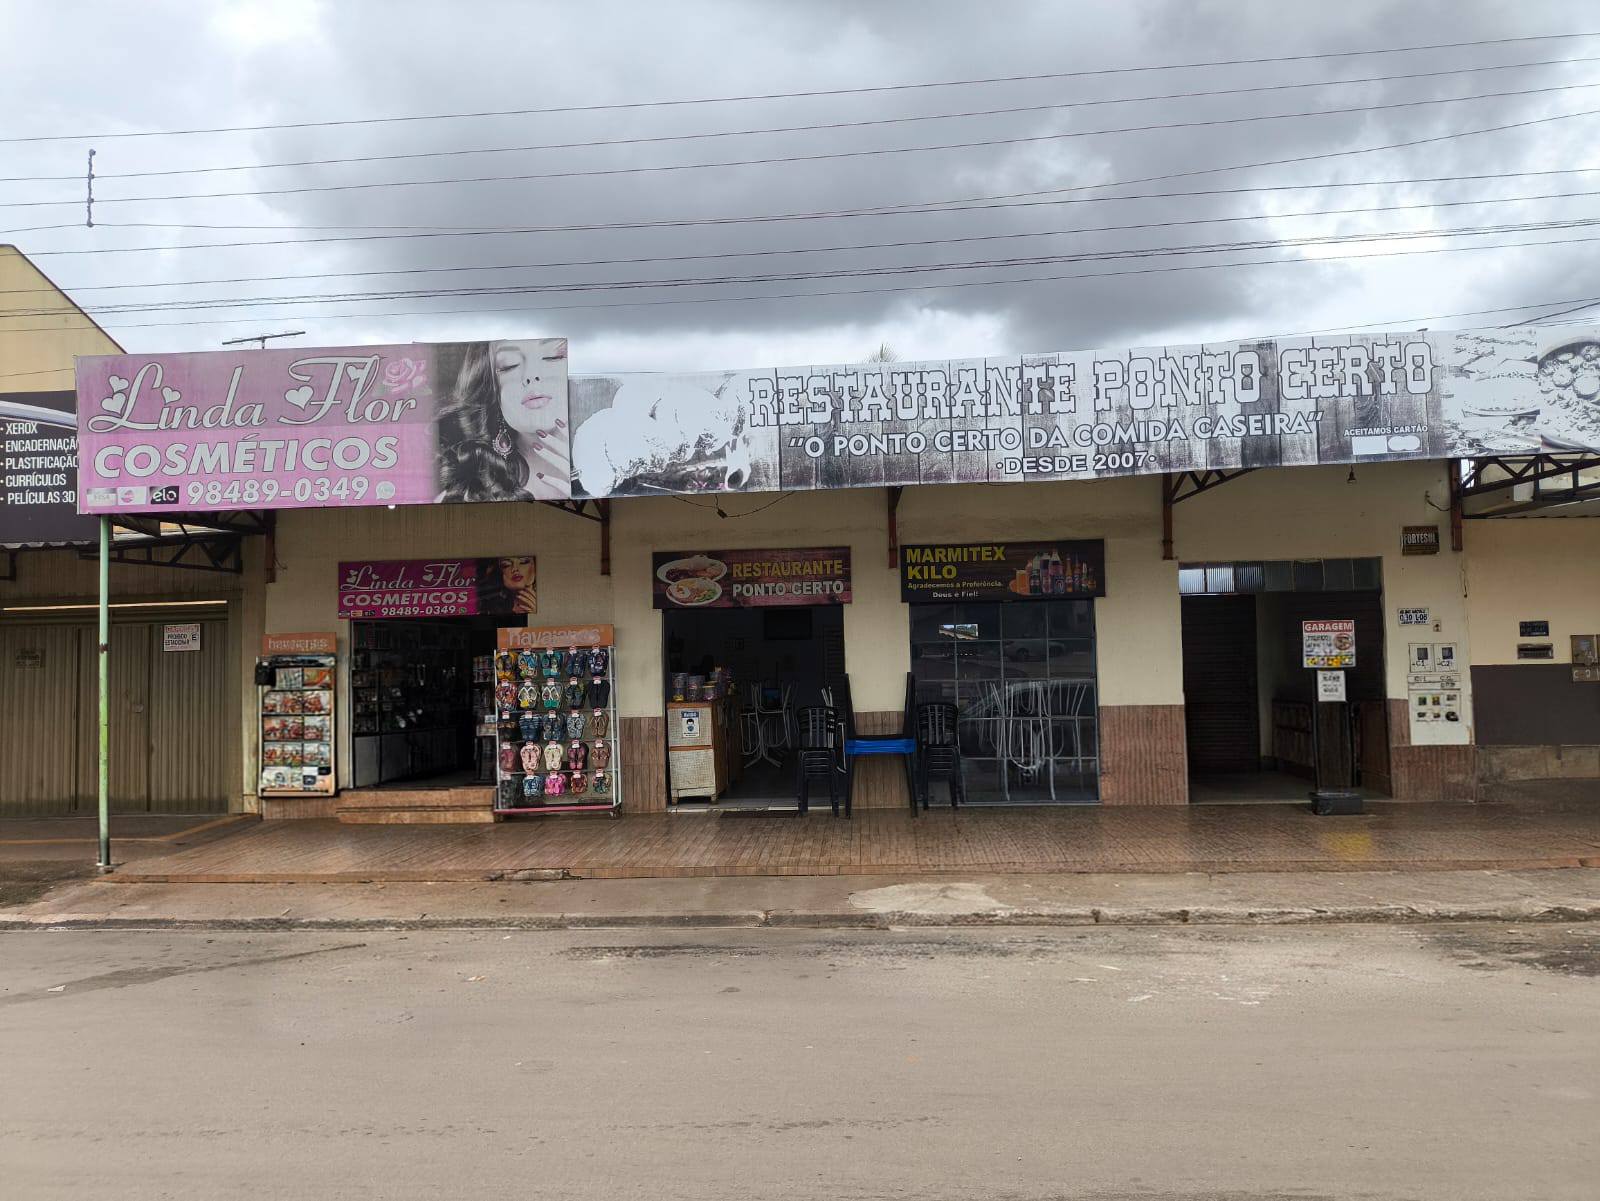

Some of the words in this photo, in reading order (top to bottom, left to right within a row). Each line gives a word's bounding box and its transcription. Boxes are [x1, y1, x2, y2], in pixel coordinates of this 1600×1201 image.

[749, 363, 1076, 427] RESTAURANTE
[1093, 350, 1261, 412] PONTO
[1278, 341, 1434, 400] CERTO
[87, 360, 266, 433] Linda
[277, 354, 417, 426] Flor
[5, 422, 38, 435] XEROX
[834, 431, 927, 457] PONTO
[934, 427, 1022, 454] CERTO
[1029, 426, 1069, 450] DA
[1073, 417, 1188, 447] COMIDA
[1344, 427, 1392, 437] ACEITAMOS
[1393, 423, 1428, 434] CARTÃO
[5, 436, 79, 453] ENCADERNAÇÃ
[93, 433, 400, 479] COSMÉTICOS
[5, 471, 67, 488] CURRÍCULOS
[7, 488, 60, 505] PELÍCULAS
[62, 490, 75, 503] 3D
[152, 488, 177, 502] elo
[186, 475, 370, 505] 98489-0349
[906, 546, 1006, 563] MARMITEX
[340, 565, 414, 591] Linda
[419, 562, 476, 588] Flor
[732, 559, 843, 577] RESTAURANTE
[906, 565, 957, 580] KILO
[732, 582, 786, 597] PONTO
[791, 580, 844, 595] CERTO
[342, 589, 468, 607] COSMÉTICOS
[381, 605, 456, 617] 98489-0349
[1304, 622, 1352, 632] GARAGEM
